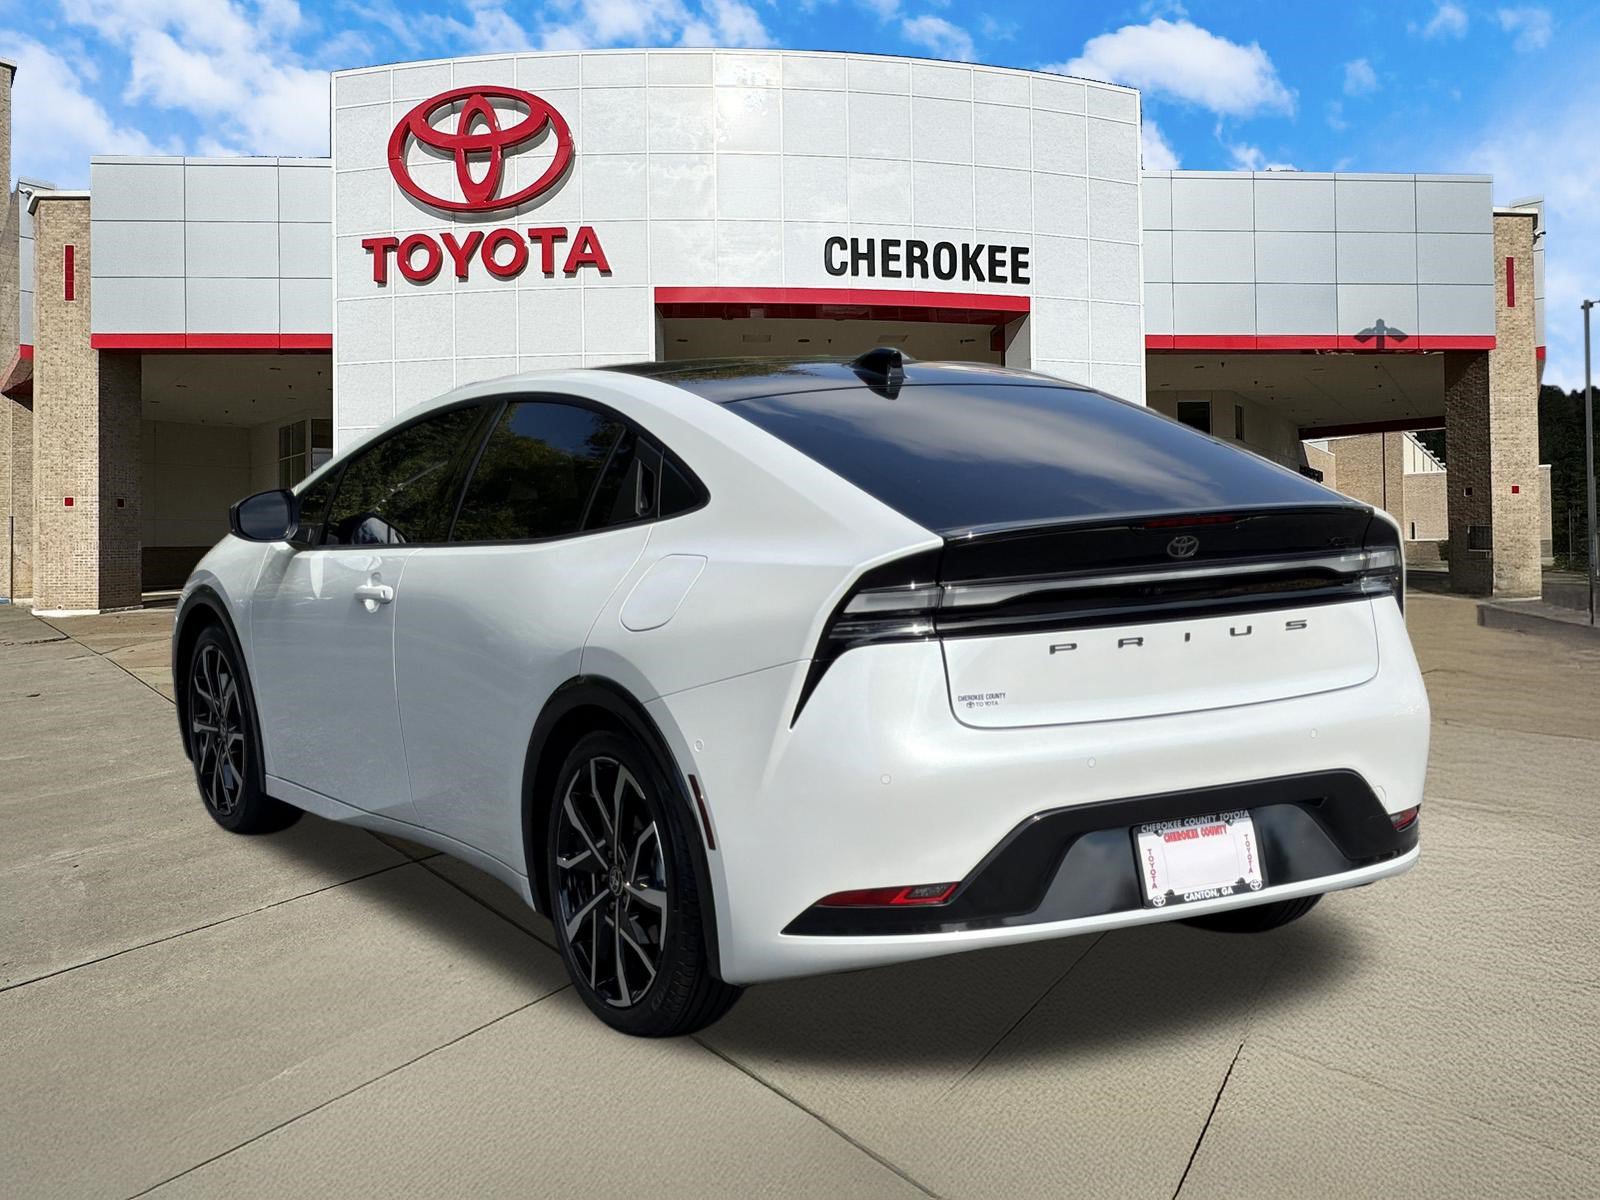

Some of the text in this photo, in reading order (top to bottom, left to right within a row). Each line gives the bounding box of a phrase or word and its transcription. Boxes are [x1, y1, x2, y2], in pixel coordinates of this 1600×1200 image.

[362, 226, 612, 287] TOYOTA
[824, 236, 1030, 285] CHEROKEE
[1049, 619, 1307, 654] PRIUS
[985, 692, 1006, 700] COUNTY
[1141, 809, 1250, 833] CHEROKEE COUNTY TOYOTA
[1163, 824, 1227, 843] CHEROKEE COUNTY
[1147, 848, 1158, 890] TOYOTA
[1244, 834, 1254, 874] TOYOTA
[1183, 886, 1234, 902] CANTON, GA
